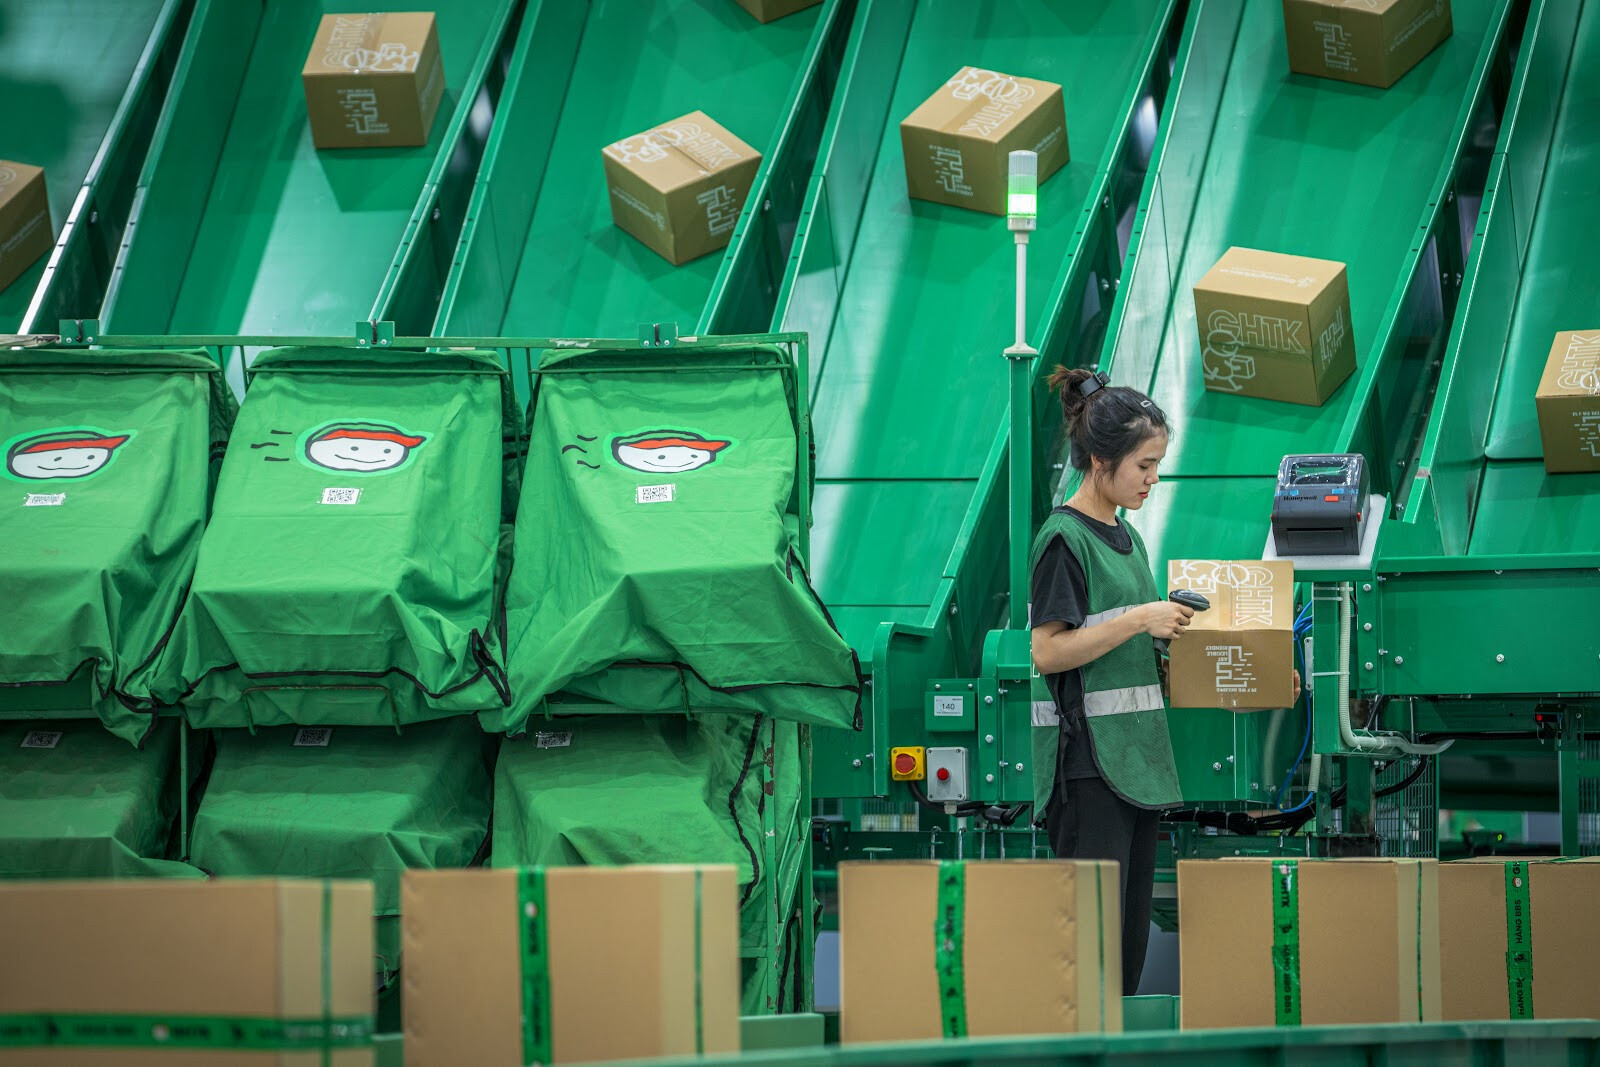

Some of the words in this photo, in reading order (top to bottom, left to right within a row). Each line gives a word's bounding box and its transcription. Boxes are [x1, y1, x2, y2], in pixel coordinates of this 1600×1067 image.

[959, 84, 1035, 137] GHTK
[1207, 309, 1306, 355] GHTK
[1235, 566, 1274, 626] GHTK
[1281, 877, 1290, 908] GHTK
[1284, 995, 1292, 1014] BBS
